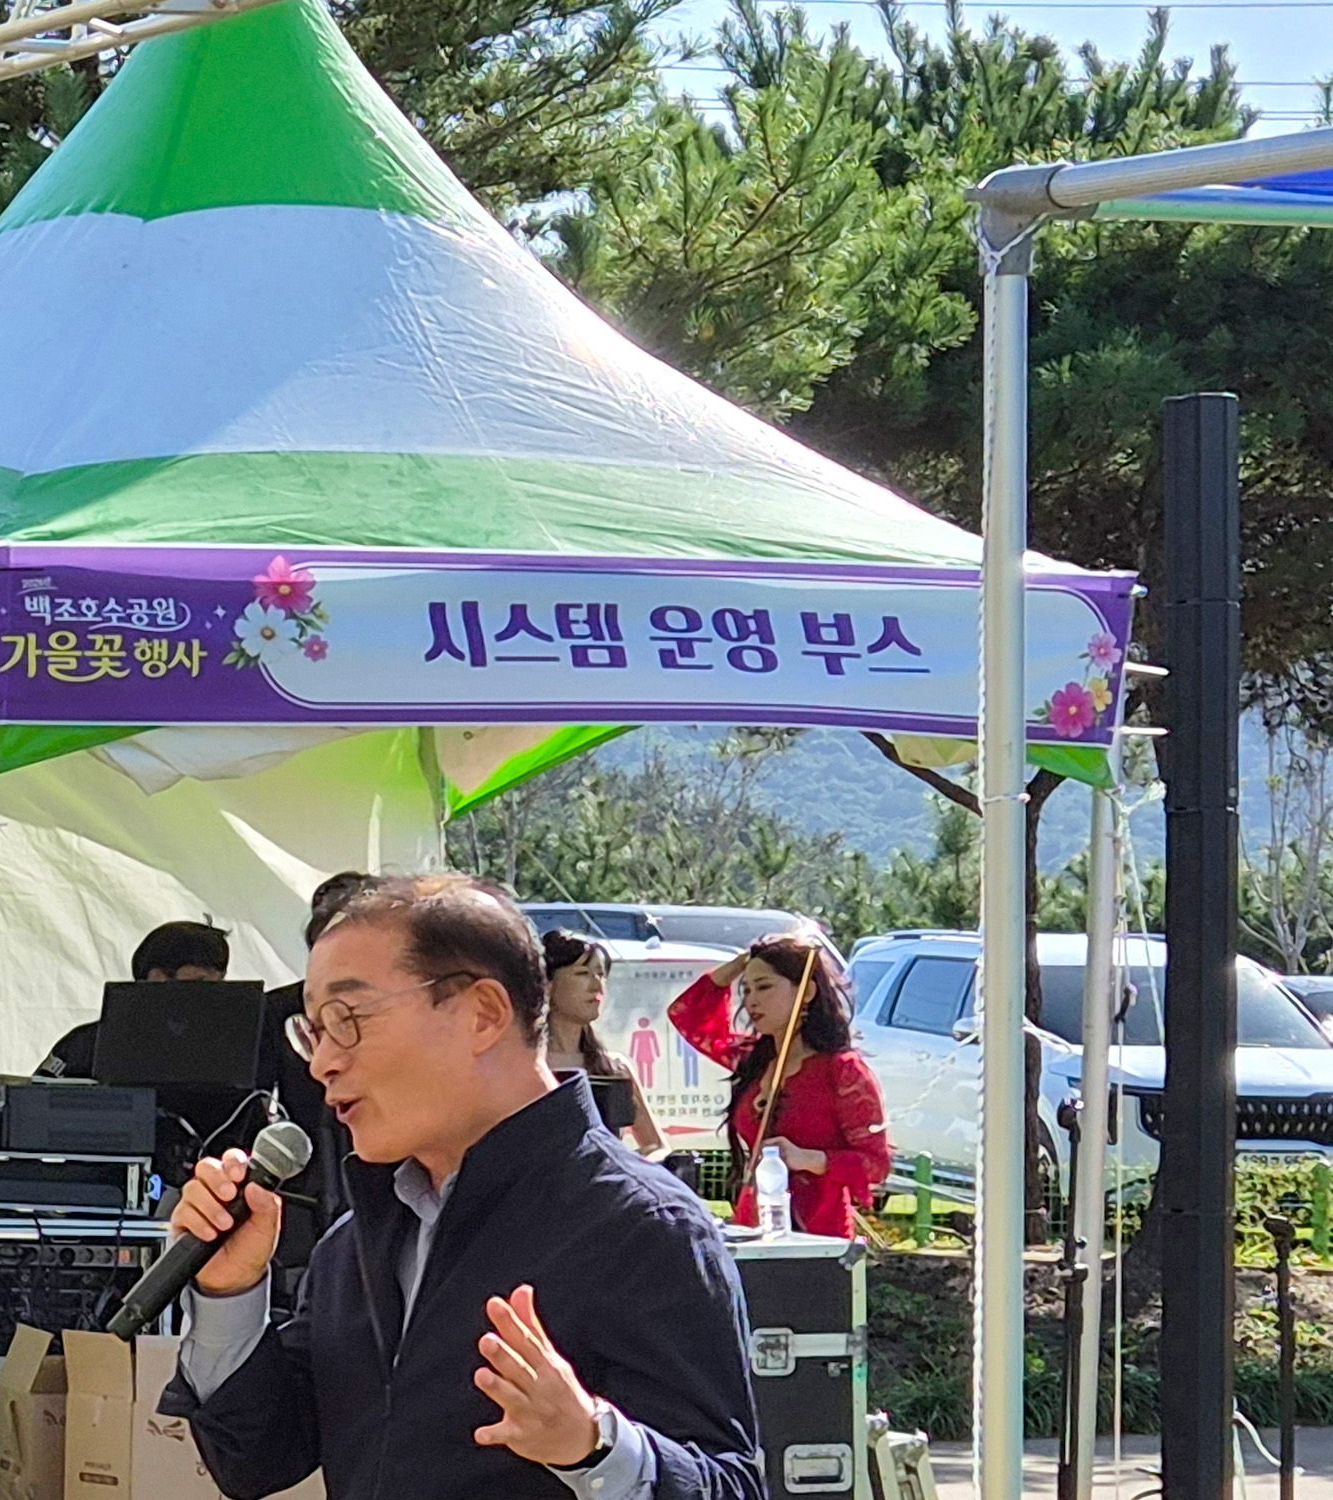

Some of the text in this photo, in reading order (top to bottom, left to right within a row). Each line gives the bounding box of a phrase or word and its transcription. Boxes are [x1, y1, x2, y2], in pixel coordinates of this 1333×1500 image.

[24, 595, 178, 626] 백조호수공원
[424, 600, 931, 675] 시스템 운영 부스
[133, 638, 208, 678] 행사
